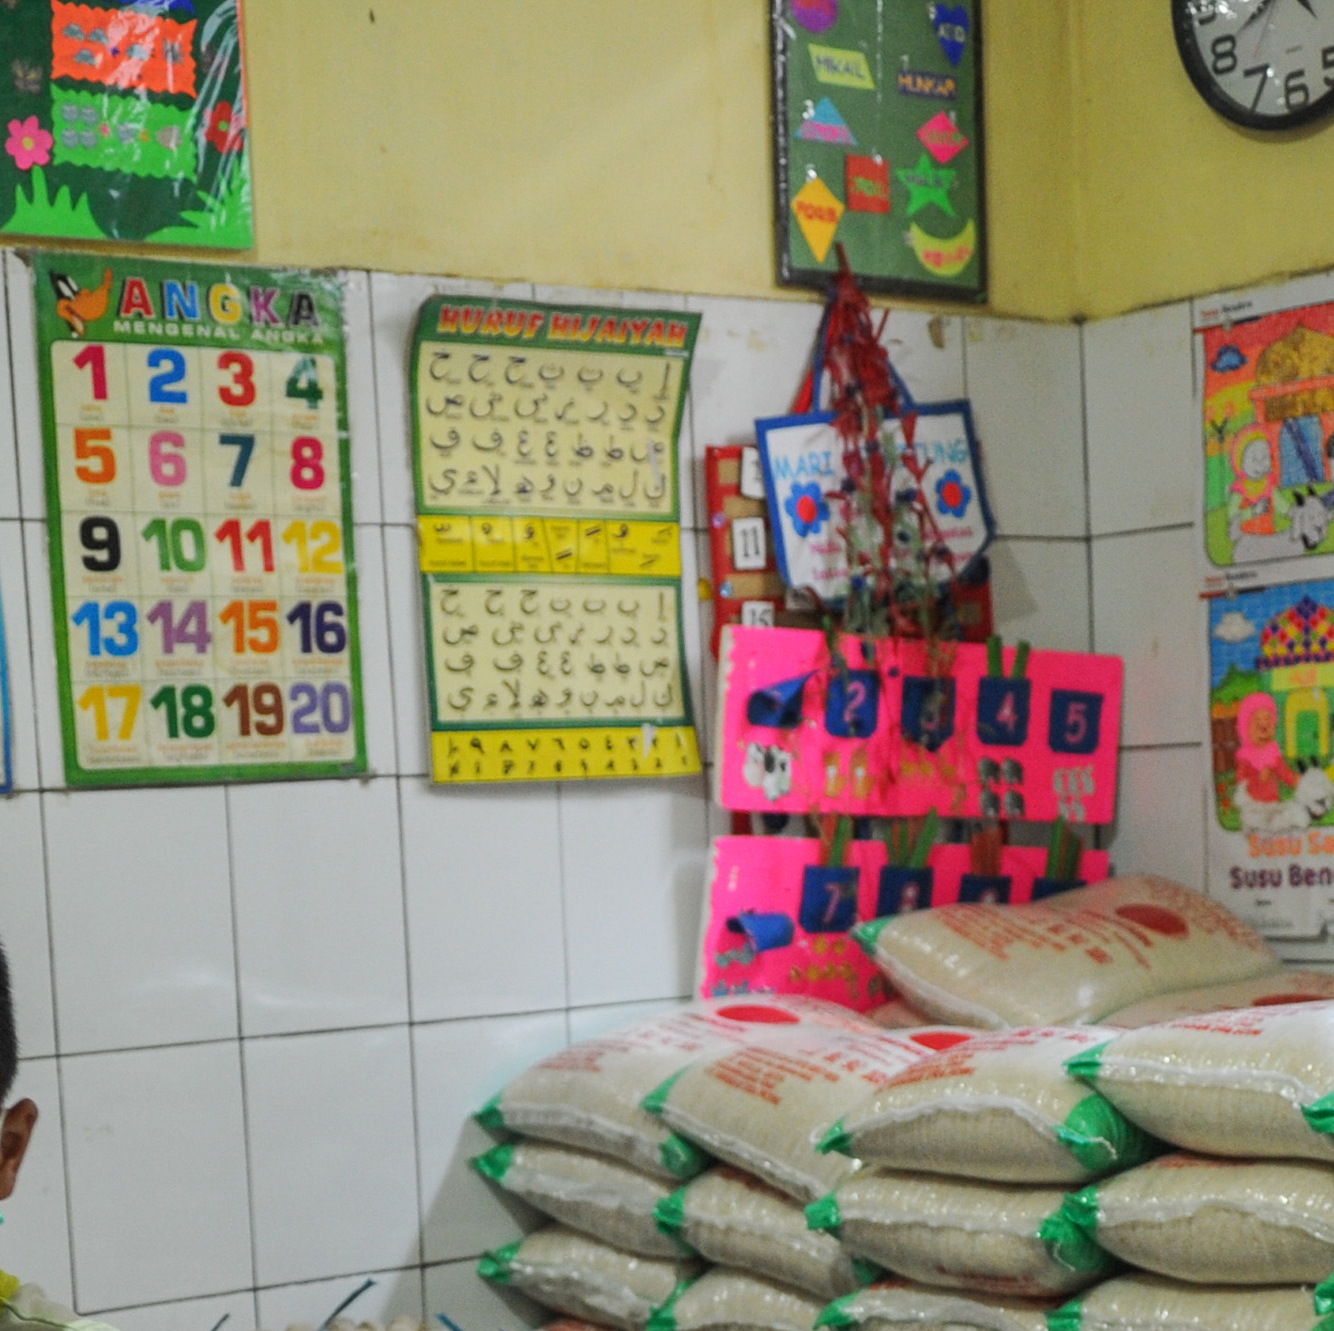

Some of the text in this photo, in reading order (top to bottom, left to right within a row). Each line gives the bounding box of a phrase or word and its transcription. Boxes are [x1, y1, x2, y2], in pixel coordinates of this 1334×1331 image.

[1211, 33, 1237, 75] 8
[1243, 63, 1269, 112] 7
[1284, 68, 1309, 110] 6
[119, 277, 321, 328] ANGKA
[436, 304, 689, 349] HURUF HIJAIYAH
[113, 320, 324, 344] MENGENAL ANGKA
[73, 345, 107, 400] 1
[146, 346, 188, 404] 2
[217, 350, 256, 407] 3
[285, 356, 323, 411] 4
[73, 426, 116, 484] 5
[148, 430, 187, 487] 6
[219, 433, 255, 487] 7
[289, 436, 325, 490] 8
[79, 516, 121, 572] 9
[141, 517, 207, 573] 10
[214, 518, 275, 573] 11
[281, 520, 344, 574] 12
[741, 529, 761, 560] 11
[71, 600, 139, 656] 13
[146, 599, 213, 655] 14
[218, 600, 280, 655] 15
[285, 601, 347, 654] 16
[77, 684, 142, 741] 17
[149, 684, 215, 738] 18
[222, 682, 285, 736] 19
[289, 682, 351, 735] 20
[997, 693, 1016, 732] 4
[1065, 702, 1087, 743] 5
[1248, 833, 1303, 857] Susu
[1230, 866, 1283, 889] Susu
